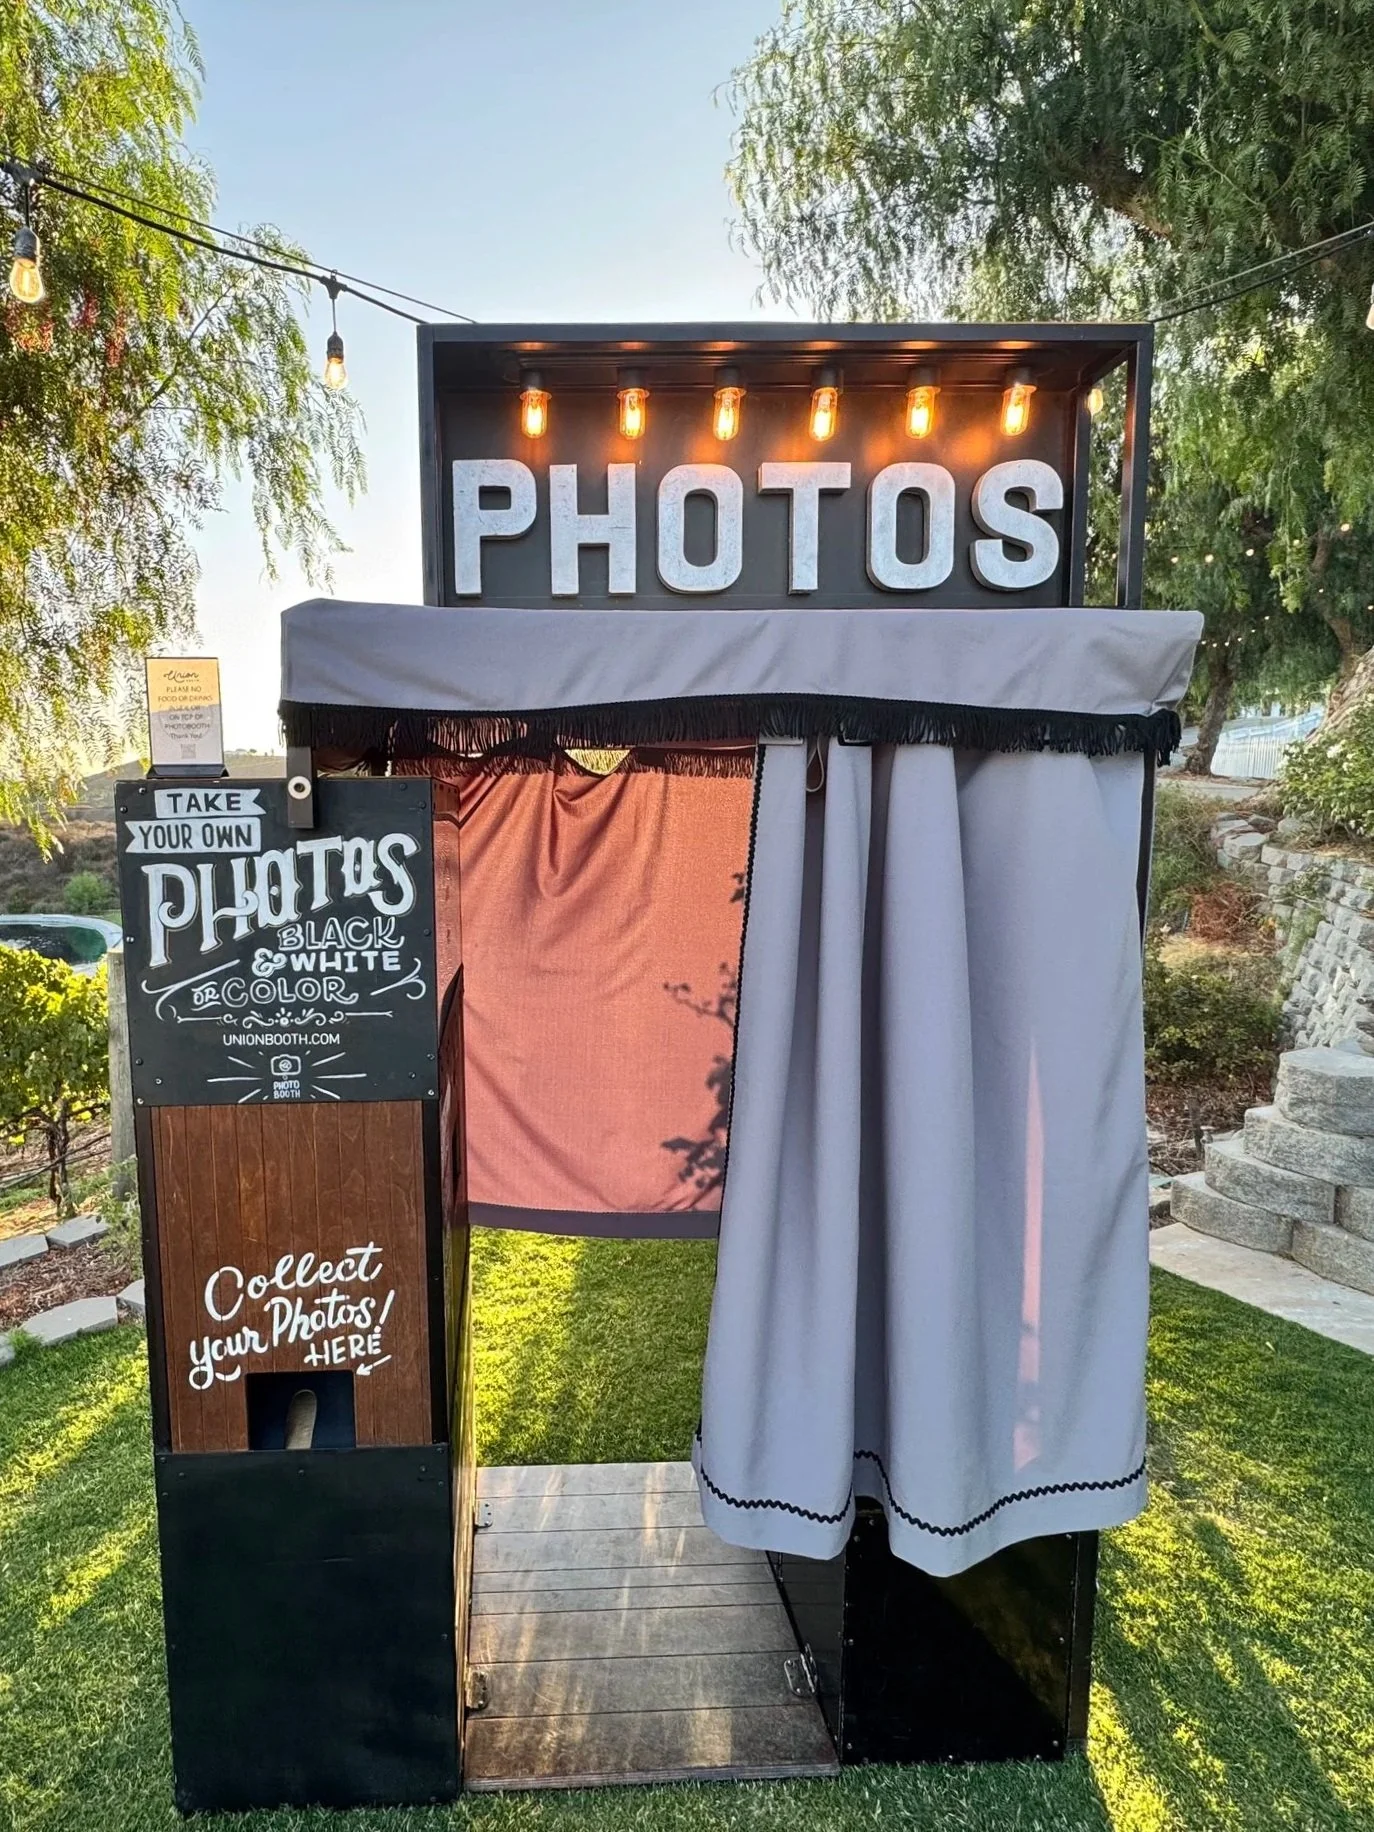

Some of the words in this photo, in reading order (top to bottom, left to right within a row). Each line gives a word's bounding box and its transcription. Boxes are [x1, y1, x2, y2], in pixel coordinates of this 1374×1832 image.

[452, 459, 1064, 597] PHOTOS
[163, 670, 199, 683] Union
[166, 792, 242, 814] TAKE
[139, 825, 193, 850] YOUR
[202, 823, 252, 848] OWN
[141, 833, 421, 968] PHOTOS
[278, 916, 405, 951] BLACK
[290, 951, 401, 973] WHITE
[192, 983, 221, 1009] OR
[221, 977, 359, 1007] COLOR
[223, 1033, 340, 1046] UNIONBOOTH.COM
[273, 1080, 300, 1090] PHOTO
[273, 1089, 300, 1099] BOOTH
[204, 1241, 383, 1322] Collect
[188, 1326, 268, 1390] your
[263, 1288, 396, 1347] Photos!
[303, 1332, 382, 1366] HERE
